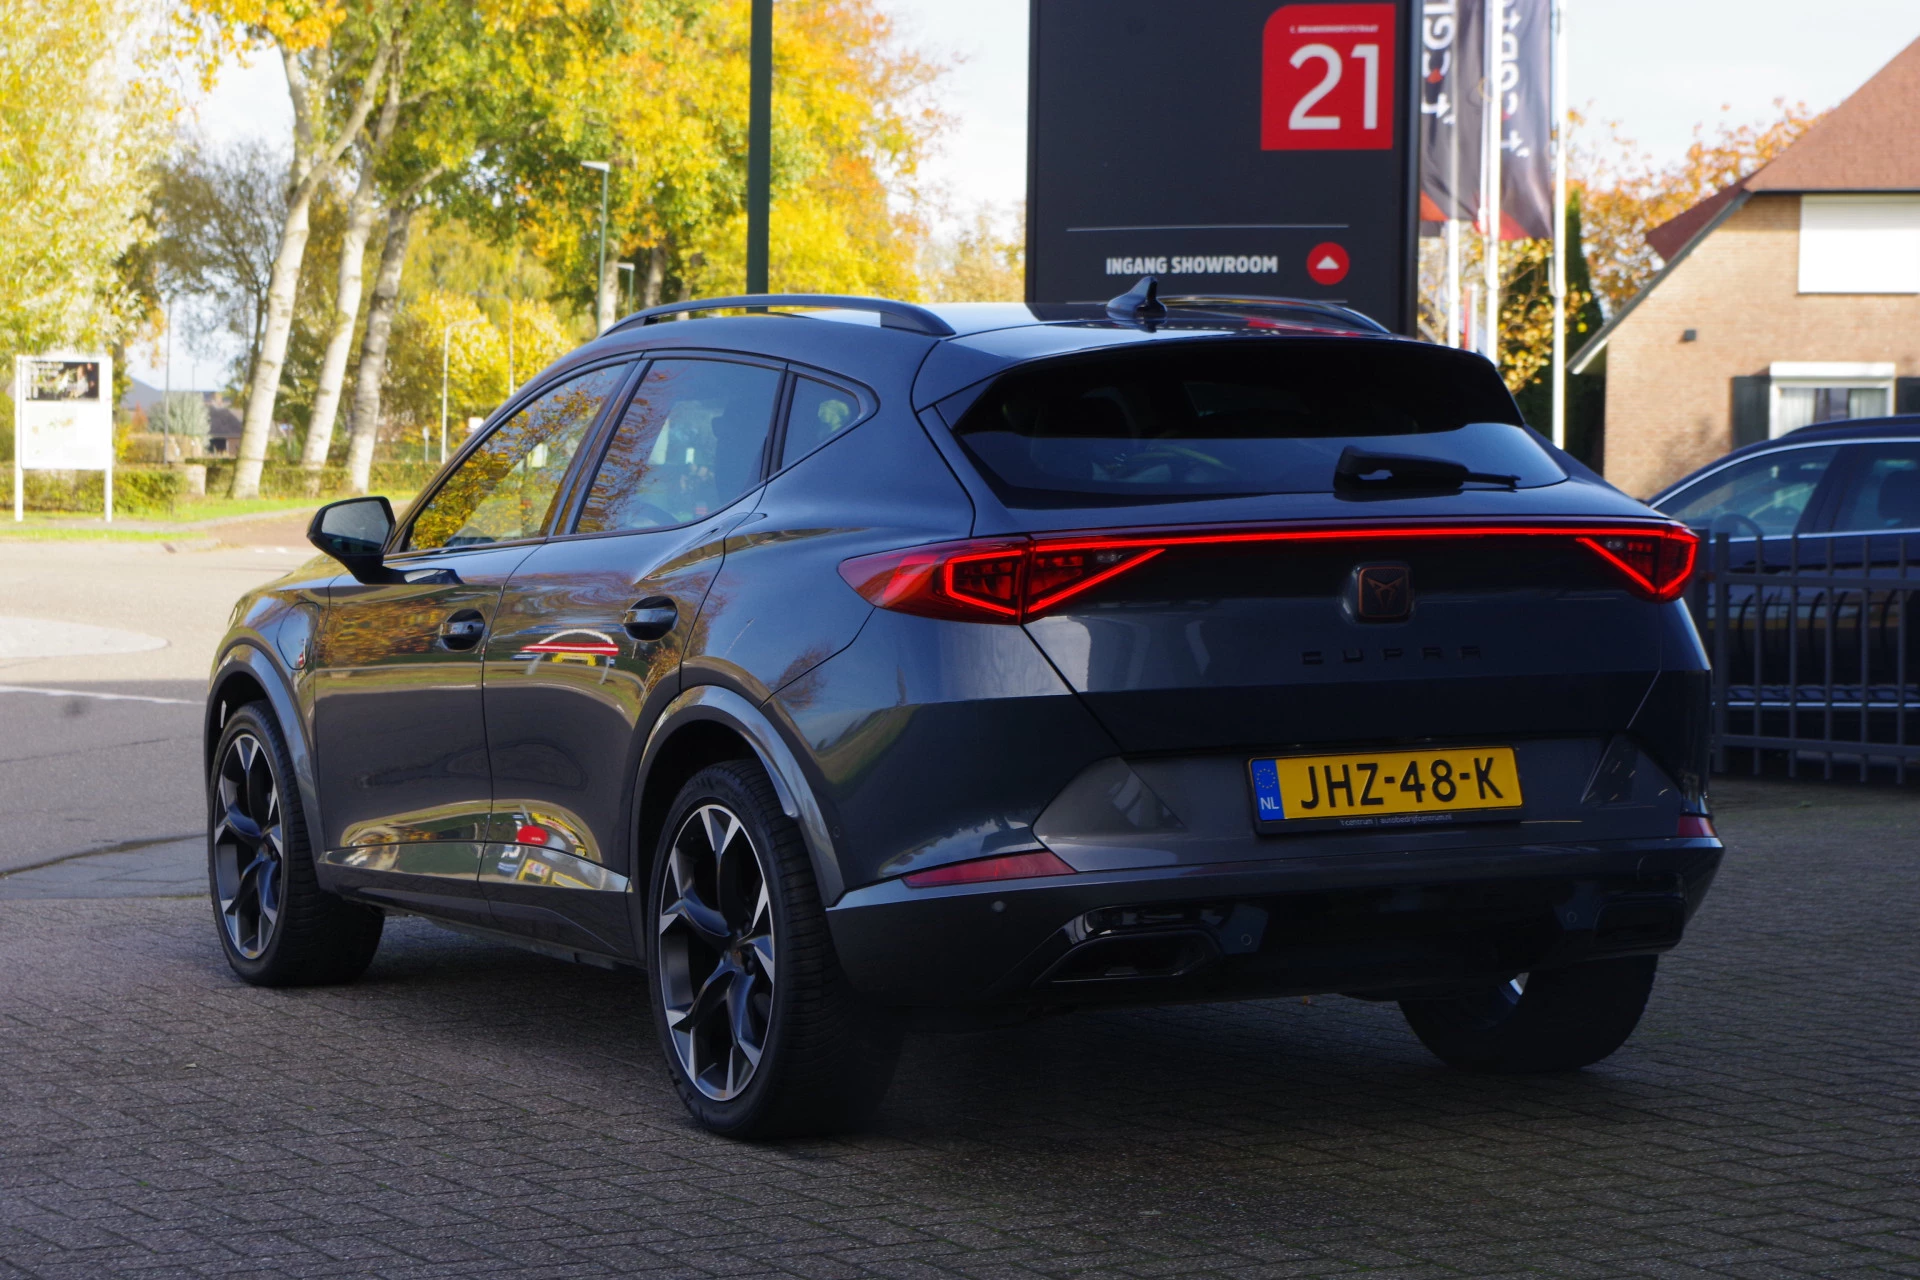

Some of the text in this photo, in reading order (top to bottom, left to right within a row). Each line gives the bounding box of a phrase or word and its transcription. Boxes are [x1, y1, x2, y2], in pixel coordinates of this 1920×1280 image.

[1288, 43, 1380, 131] 21
[1106, 255, 1279, 276] INGANG SHOWROOM
[1302, 645, 1481, 665] CUPRA
[1301, 757, 1504, 810] JHZ-48-K
[1260, 797, 1280, 811] NL
